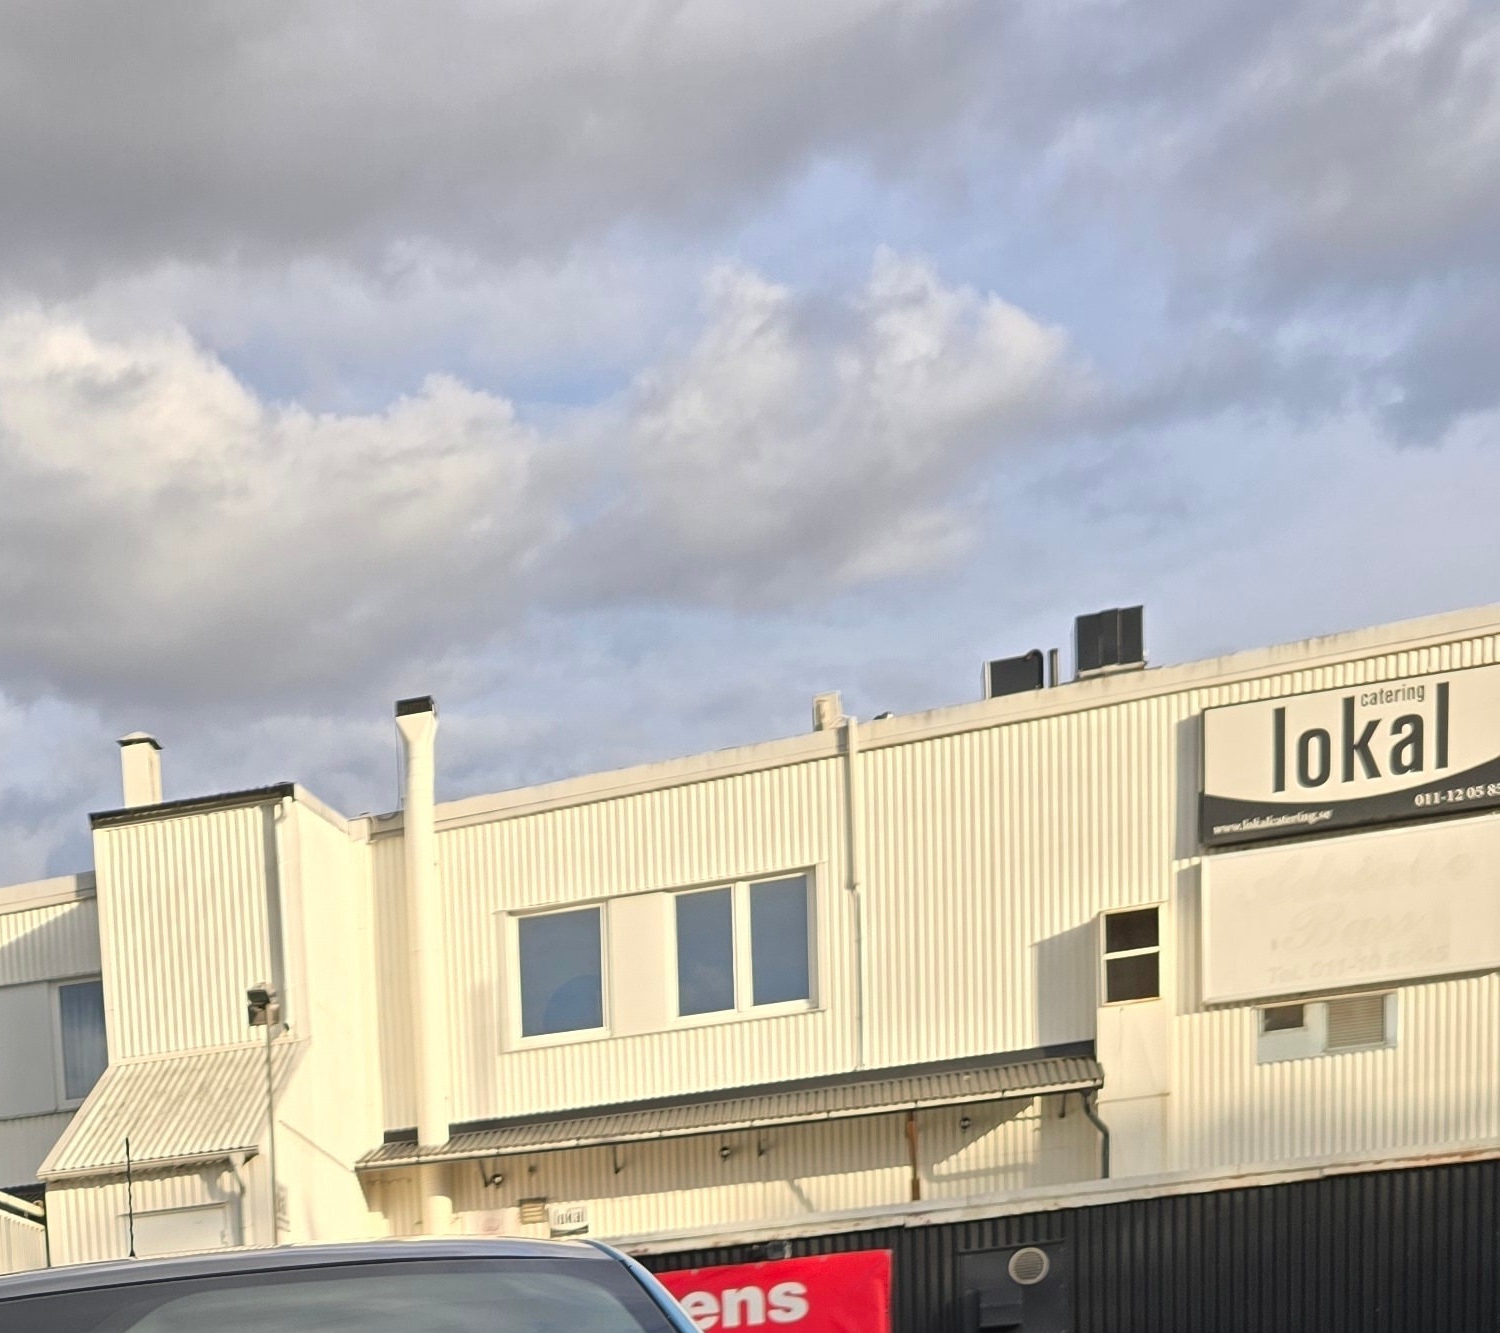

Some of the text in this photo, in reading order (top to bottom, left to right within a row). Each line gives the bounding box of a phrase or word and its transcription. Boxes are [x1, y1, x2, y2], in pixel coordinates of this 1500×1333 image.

[1360, 683, 1425, 707] catering
[1272, 681, 1450, 793] lokal
[1414, 787, 1465, 807] 011-12
[1466, 784, 1485, 800] 05
